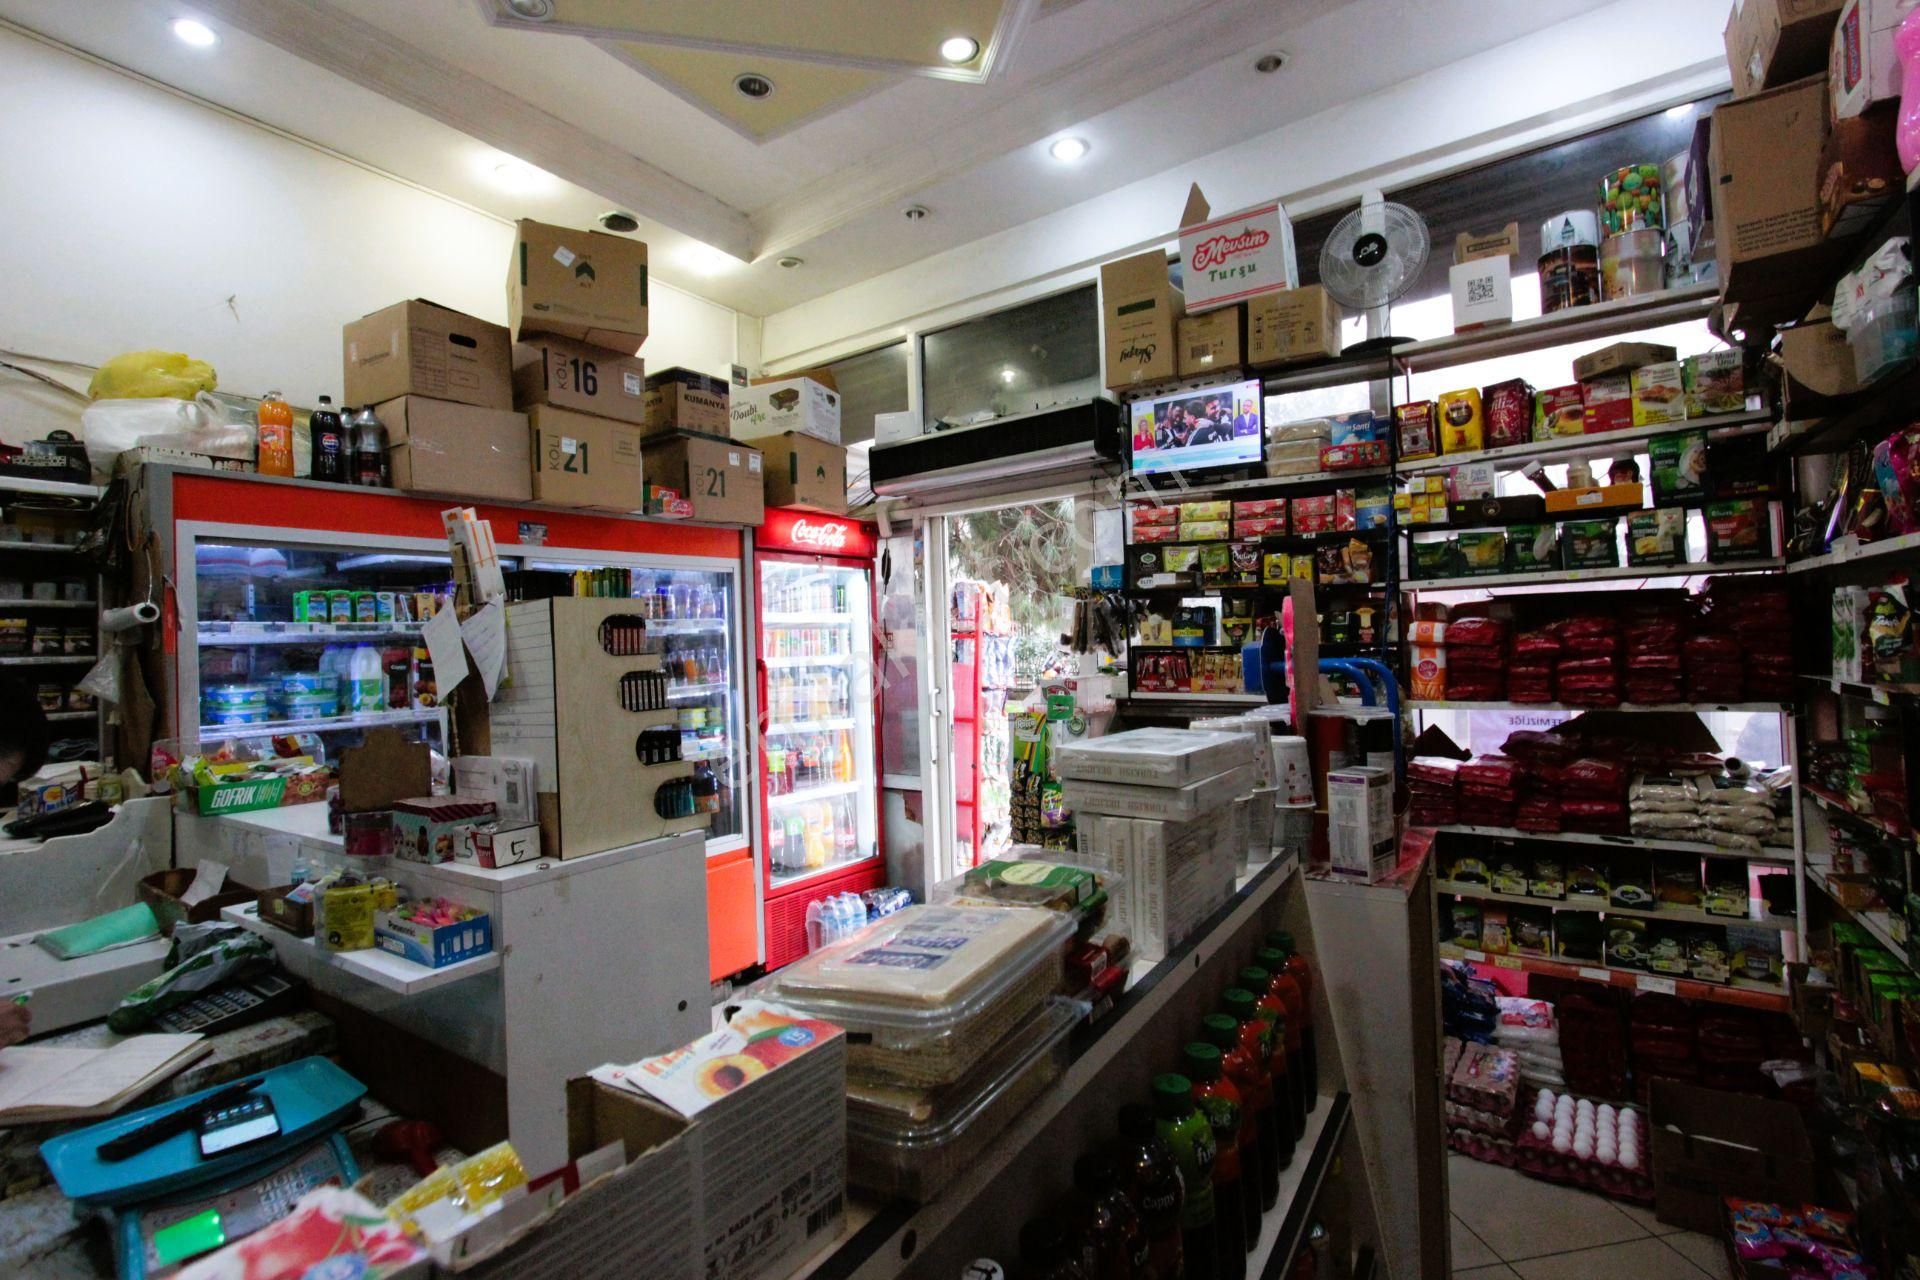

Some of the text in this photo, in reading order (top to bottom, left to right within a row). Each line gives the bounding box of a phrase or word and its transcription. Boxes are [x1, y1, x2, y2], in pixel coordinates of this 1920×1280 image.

[1208, 263, 1257, 284] Turşu
[569, 357, 598, 397] 16
[683, 393, 727, 411] KUMANYA
[562, 441, 589, 475] 21
[706, 466, 726, 498] 21
[510, 839, 527, 864] 5
[387, 919, 416, 939] Panasonic
